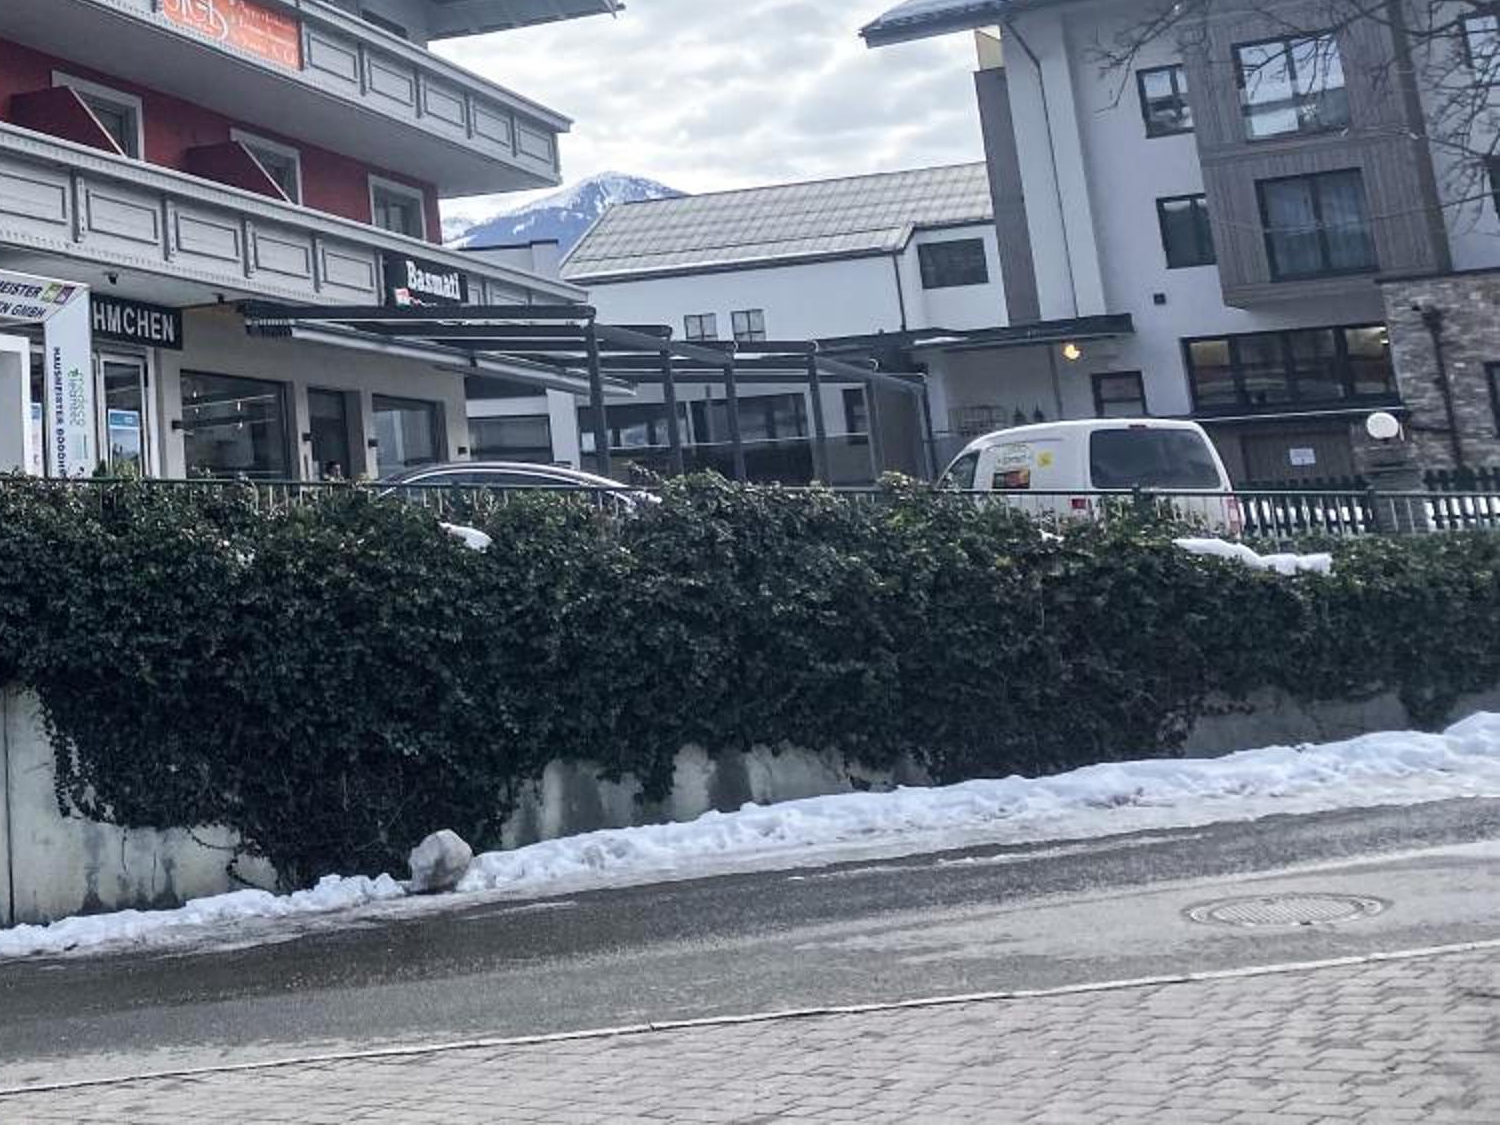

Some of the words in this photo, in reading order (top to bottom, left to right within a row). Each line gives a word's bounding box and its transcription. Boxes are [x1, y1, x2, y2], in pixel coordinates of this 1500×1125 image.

[406, 261, 460, 300] Basmati
[93, 301, 175, 342] HMCHEN
[53, 346, 64, 425] HAUSMEISTER
